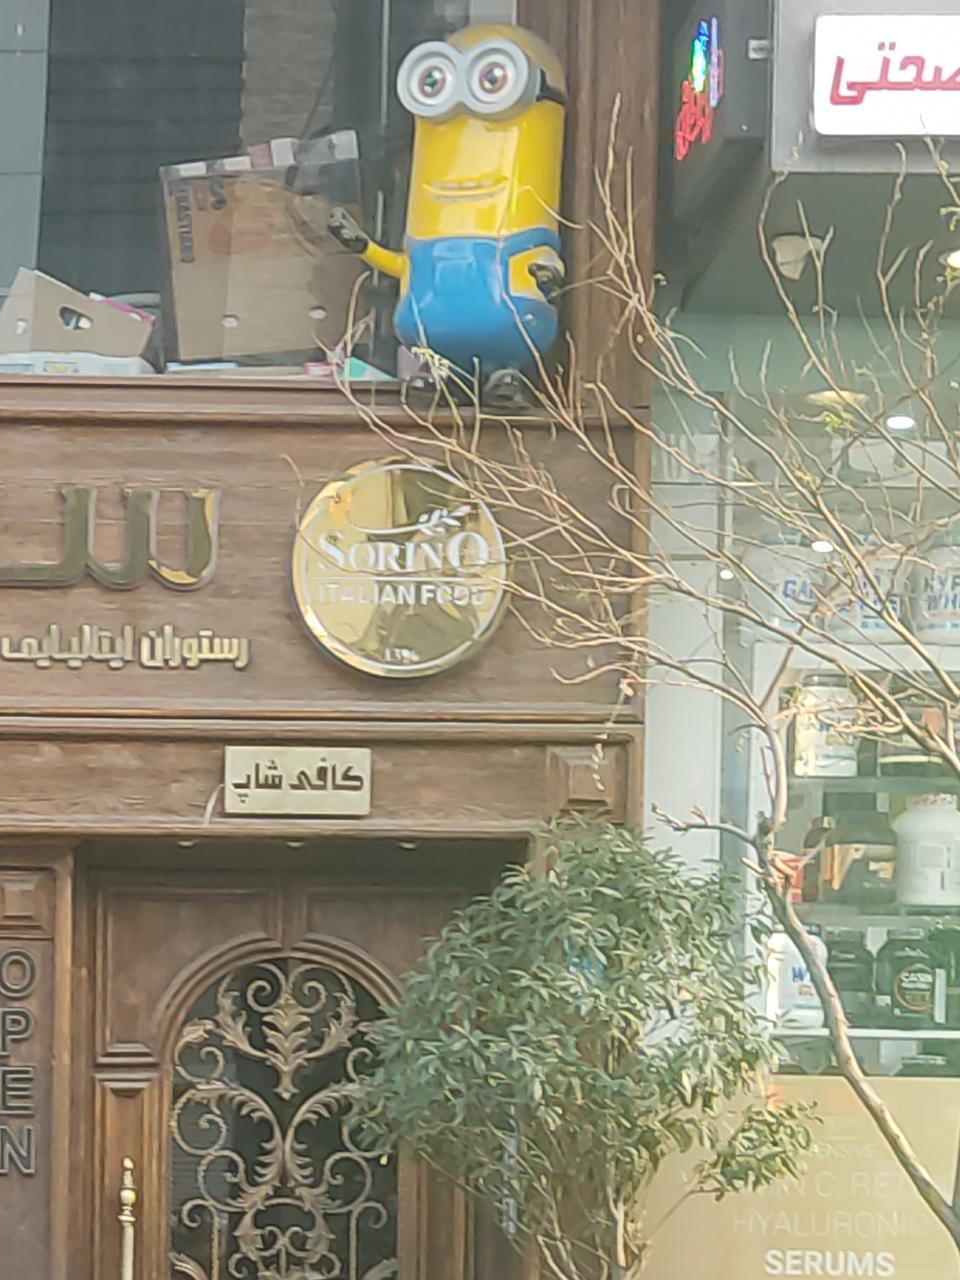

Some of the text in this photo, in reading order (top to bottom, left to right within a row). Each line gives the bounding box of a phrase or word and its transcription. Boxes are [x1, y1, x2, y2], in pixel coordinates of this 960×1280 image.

[318, 583, 487, 606] ITALIAN FOOD
[139, 623, 250, 670] رستوران
[231, 756, 365, 804] کافی شاپ
[763, 1249, 896, 1277] SERUMS
